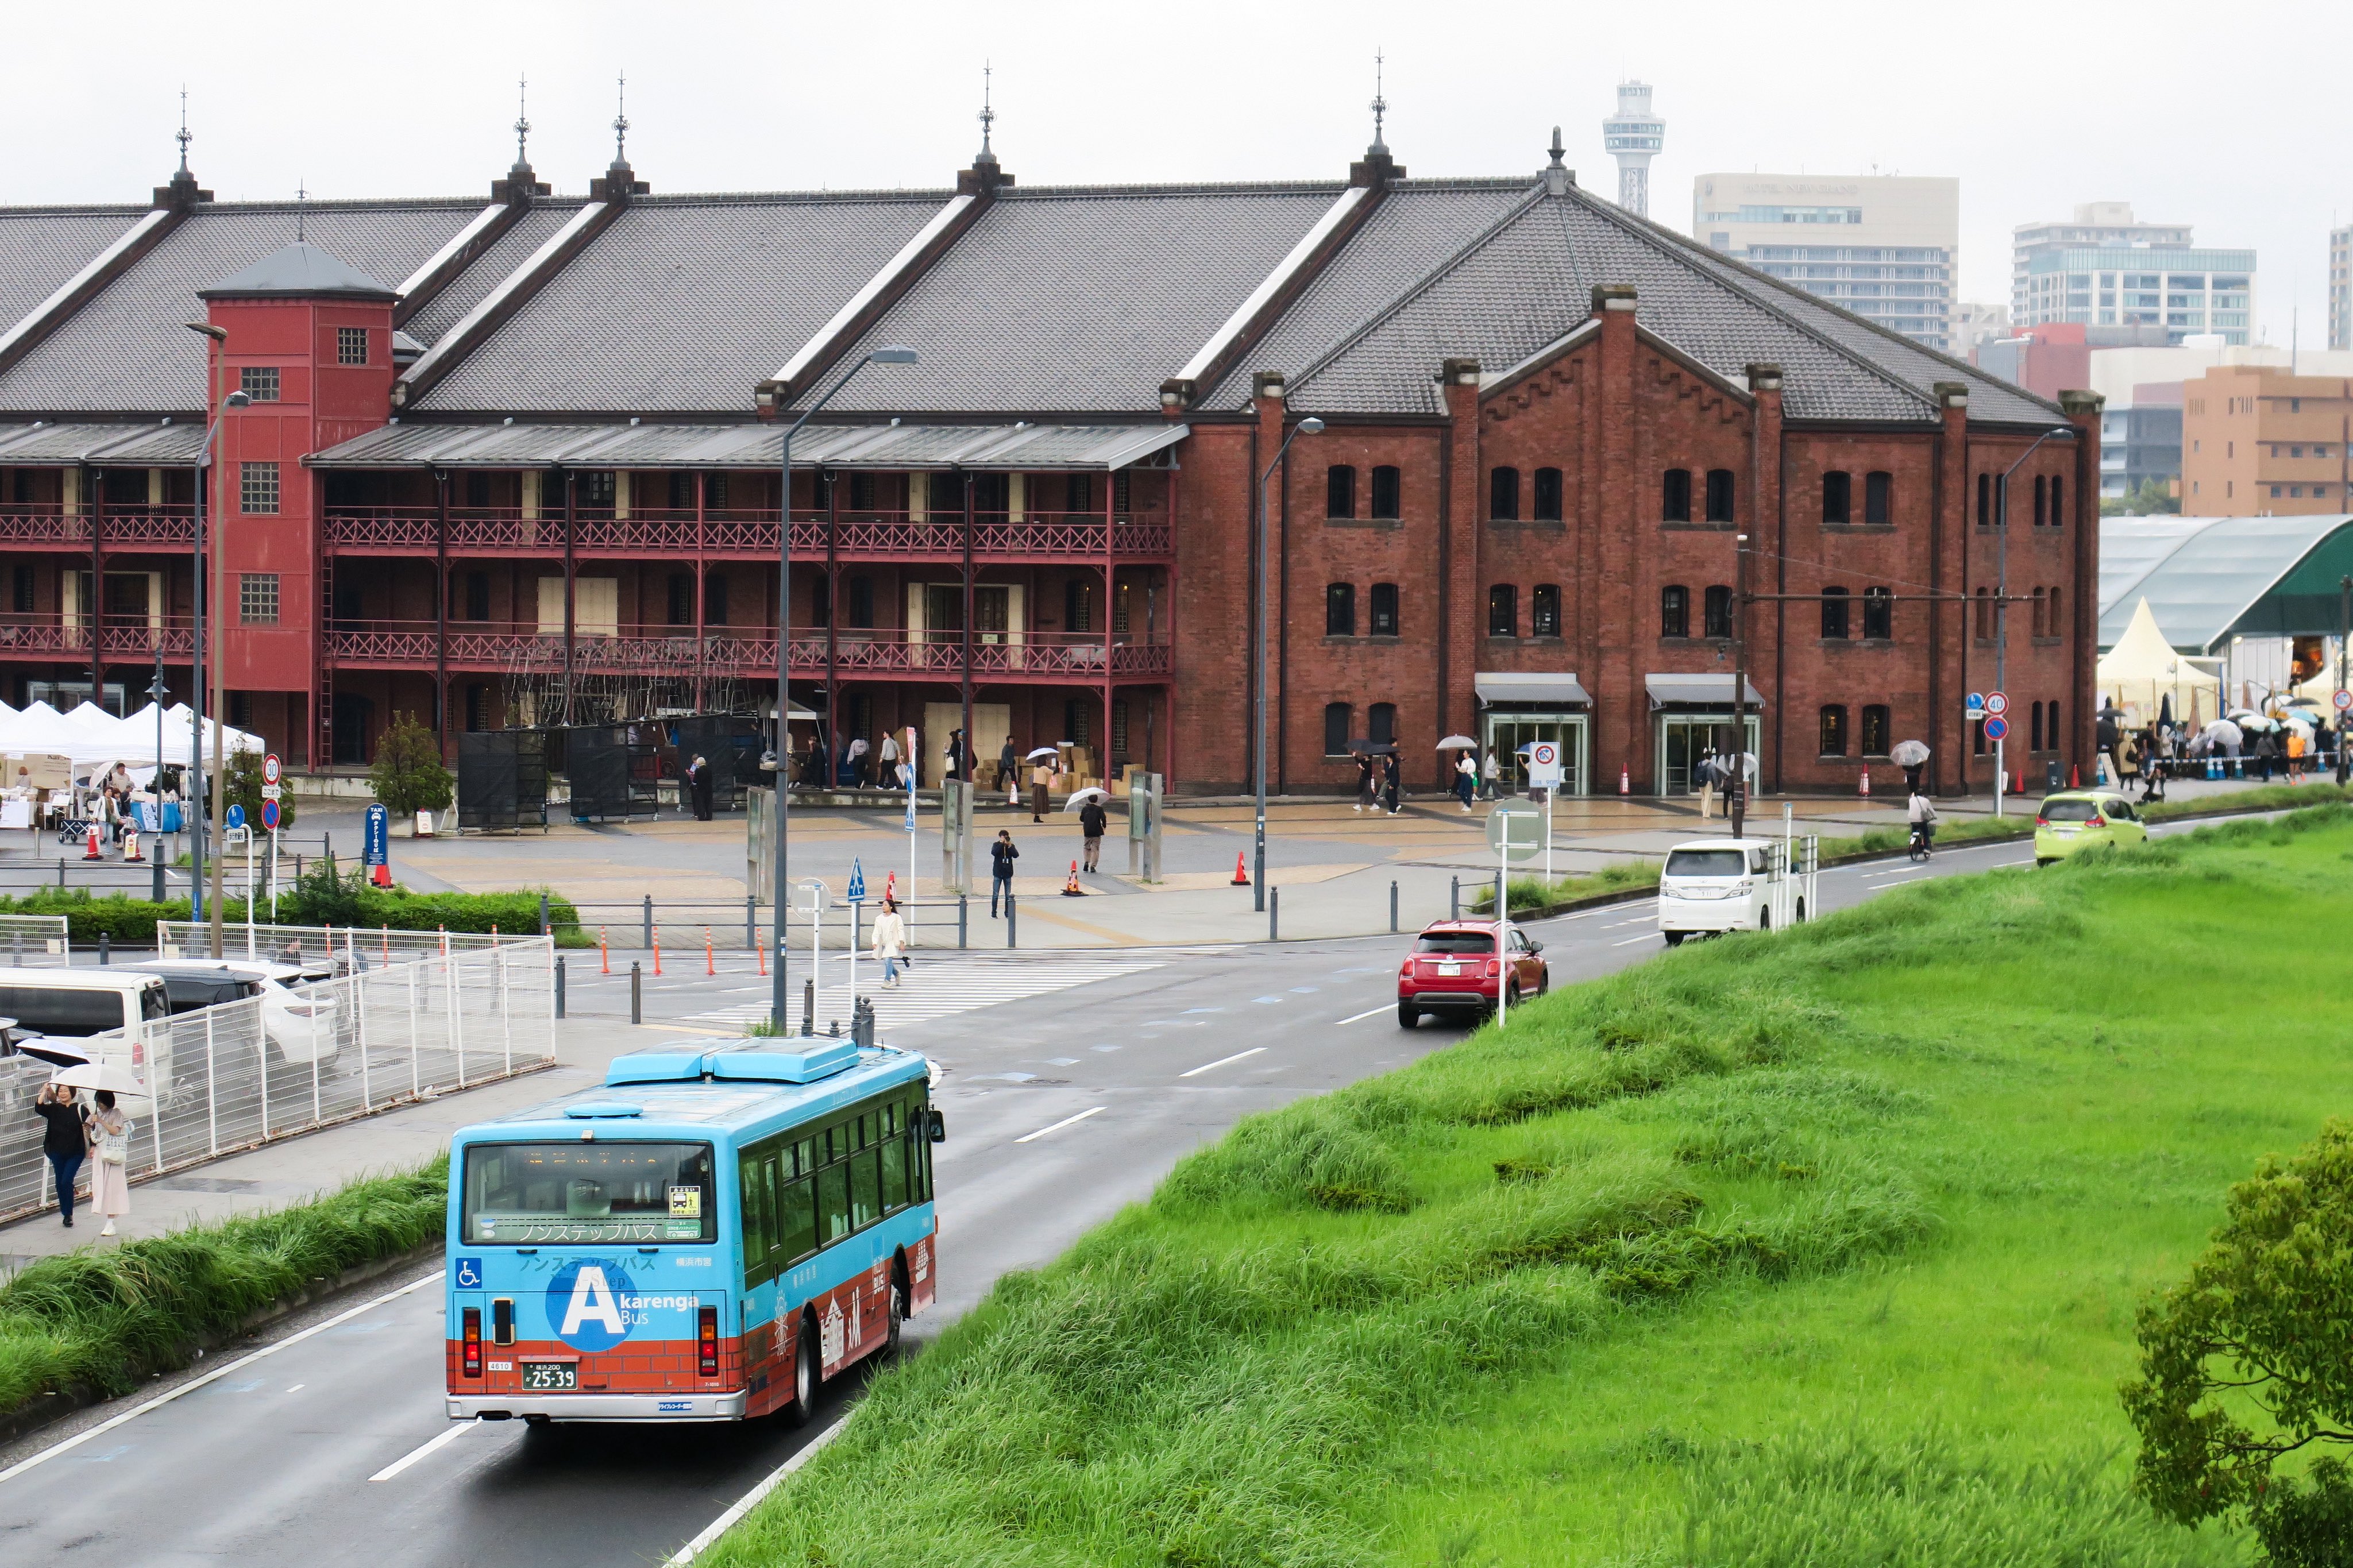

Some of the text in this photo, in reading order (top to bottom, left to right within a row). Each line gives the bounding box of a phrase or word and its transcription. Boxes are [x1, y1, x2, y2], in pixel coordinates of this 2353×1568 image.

[1990, 699, 2003, 709] 40
[267, 763, 277, 777] 30
[519, 1223, 657, 1241] ノンステップバス
[520, 1255, 655, 1272] ノンステップバス
[676, 1257, 712, 1267] 横浜市営
[621, 1310, 649, 1325] Bus
[533, 1370, 574, 1387] 25-39
